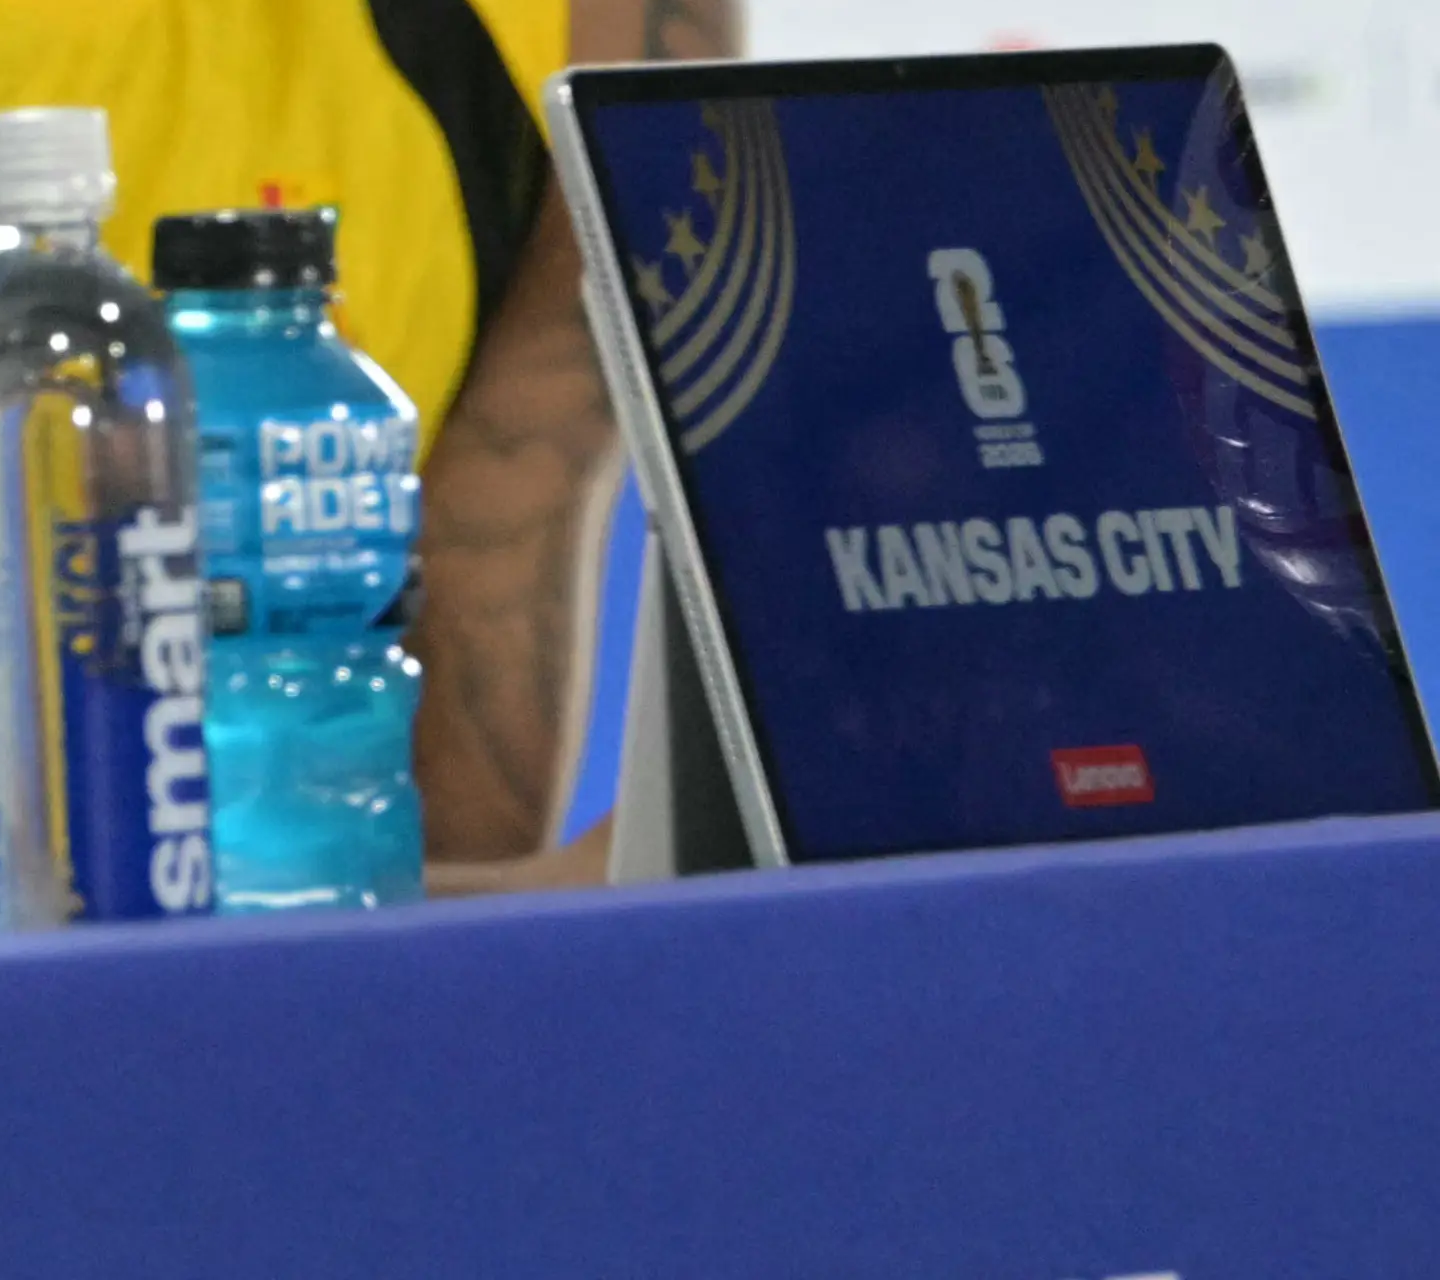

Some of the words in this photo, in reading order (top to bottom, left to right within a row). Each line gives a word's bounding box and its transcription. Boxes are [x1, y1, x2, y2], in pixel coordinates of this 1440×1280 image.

[824, 513, 1099, 612] KANSAS
[1096, 505, 1243, 596] CITY
[118, 503, 211, 912] smart
